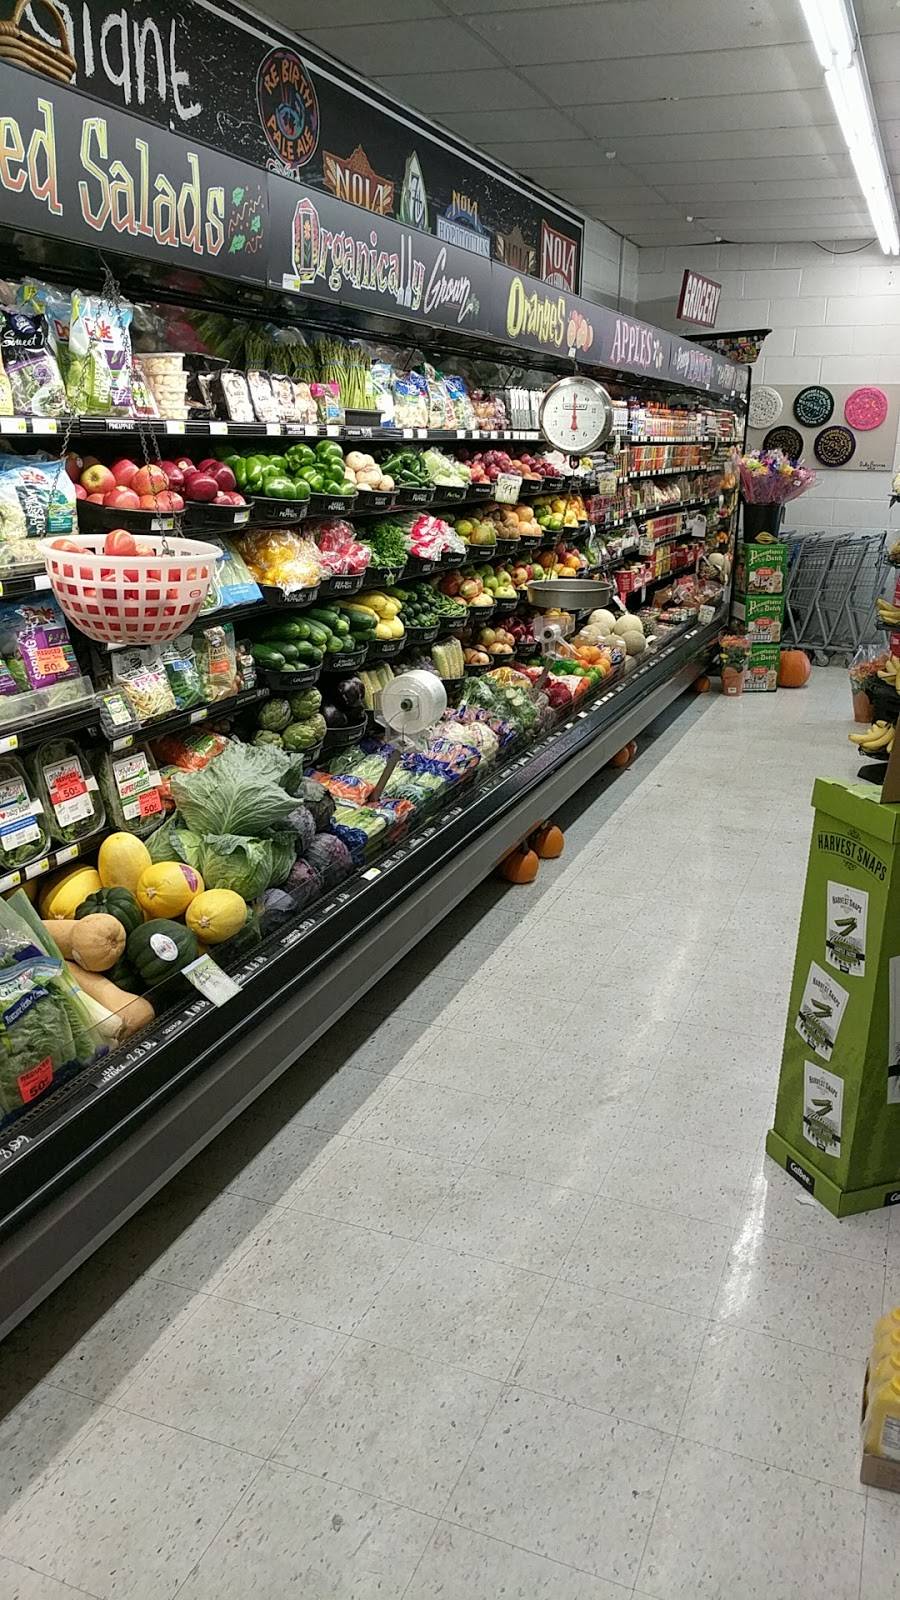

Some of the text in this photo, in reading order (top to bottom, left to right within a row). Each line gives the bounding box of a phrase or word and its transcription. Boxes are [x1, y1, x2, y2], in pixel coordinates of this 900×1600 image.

[281, 60, 312, 108] BIRTH
[267, 114, 313, 160] PALE ALE
[78, 117, 225, 256] Salads
[336, 163, 386, 215] NOLA
[452, 189, 478, 225] NOLA
[292, 197, 474, 324] Organically Grown
[542, 227, 576, 294] NOLA
[506, 276, 566, 348] Oranges
[682, 274, 721, 325] GROCERY
[2, 331, 36, 348] Sweet
[610, 319, 653, 367] APPLES
[818, 833, 888, 881] HARVEST SNAPS
[849, 899, 863, 914] SNAPS
[790, 1162, 811, 1184] Calbee
